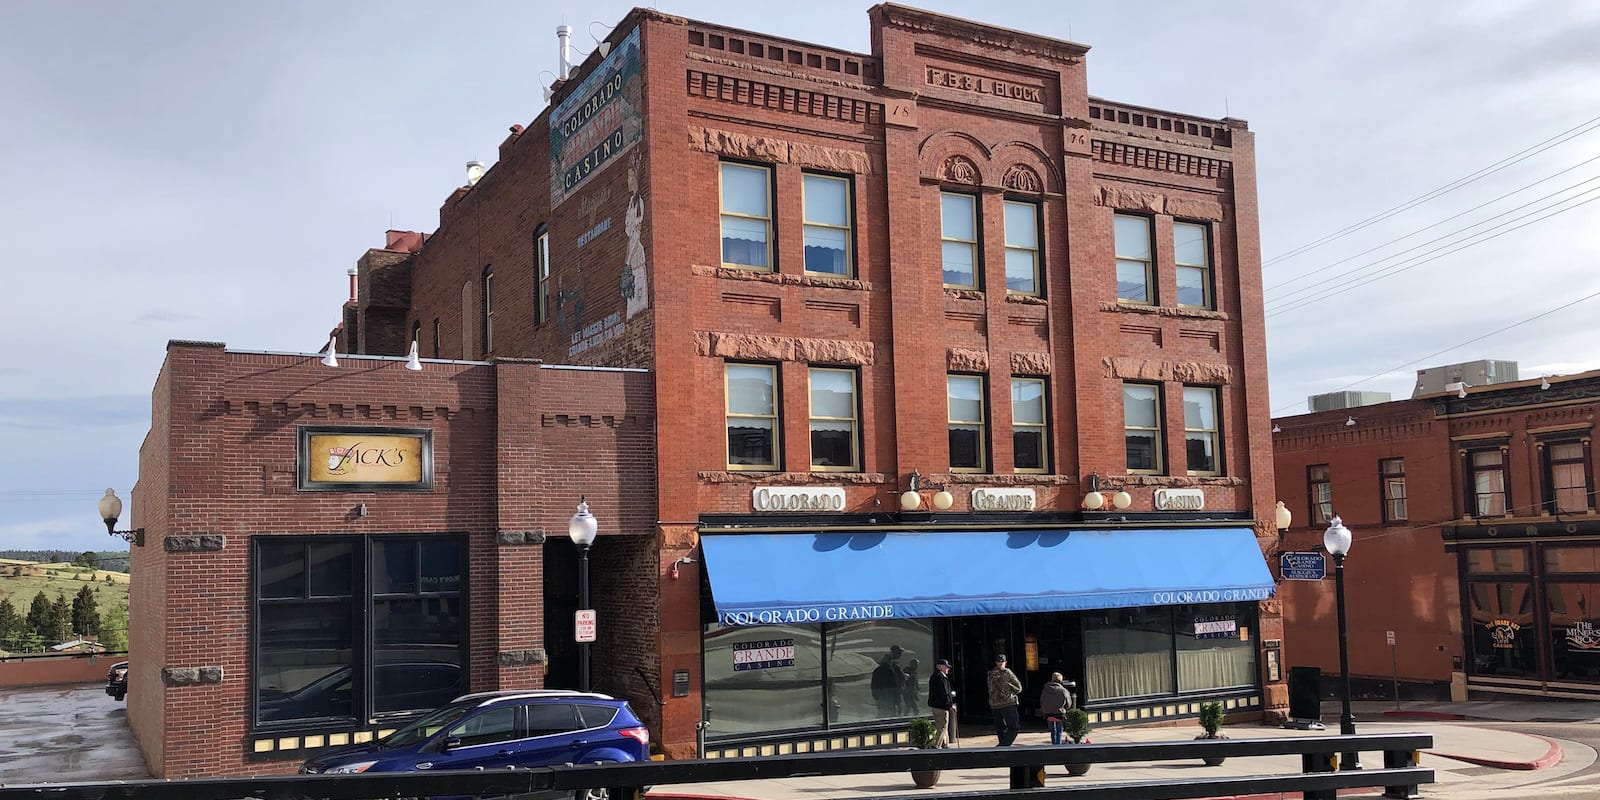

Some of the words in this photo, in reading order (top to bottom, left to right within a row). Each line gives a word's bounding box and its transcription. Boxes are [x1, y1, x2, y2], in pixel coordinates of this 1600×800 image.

[995, 81, 1040, 102] BLOCK
[563, 73, 622, 138] COLORADO
[893, 105, 909, 118] 18
[563, 99, 623, 168] GRANDE
[565, 131, 622, 188] CASINO
[577, 216, 611, 248] RESTAURANT
[328, 441, 407, 471] JACK'S
[1153, 589, 1220, 604] COLORADO
[1224, 587, 1271, 601] GRANDE
[725, 608, 820, 626] COLORADO
[826, 605, 895, 620] GRANDE
[1194, 614, 1236, 623] COLORADO
[1574, 621, 1593, 630] THE
[1196, 630, 1237, 640] CASINO
[734, 640, 794, 650] COLORADO
[734, 647, 794, 662] GRANDE
[734, 660, 795, 671] CASINO
